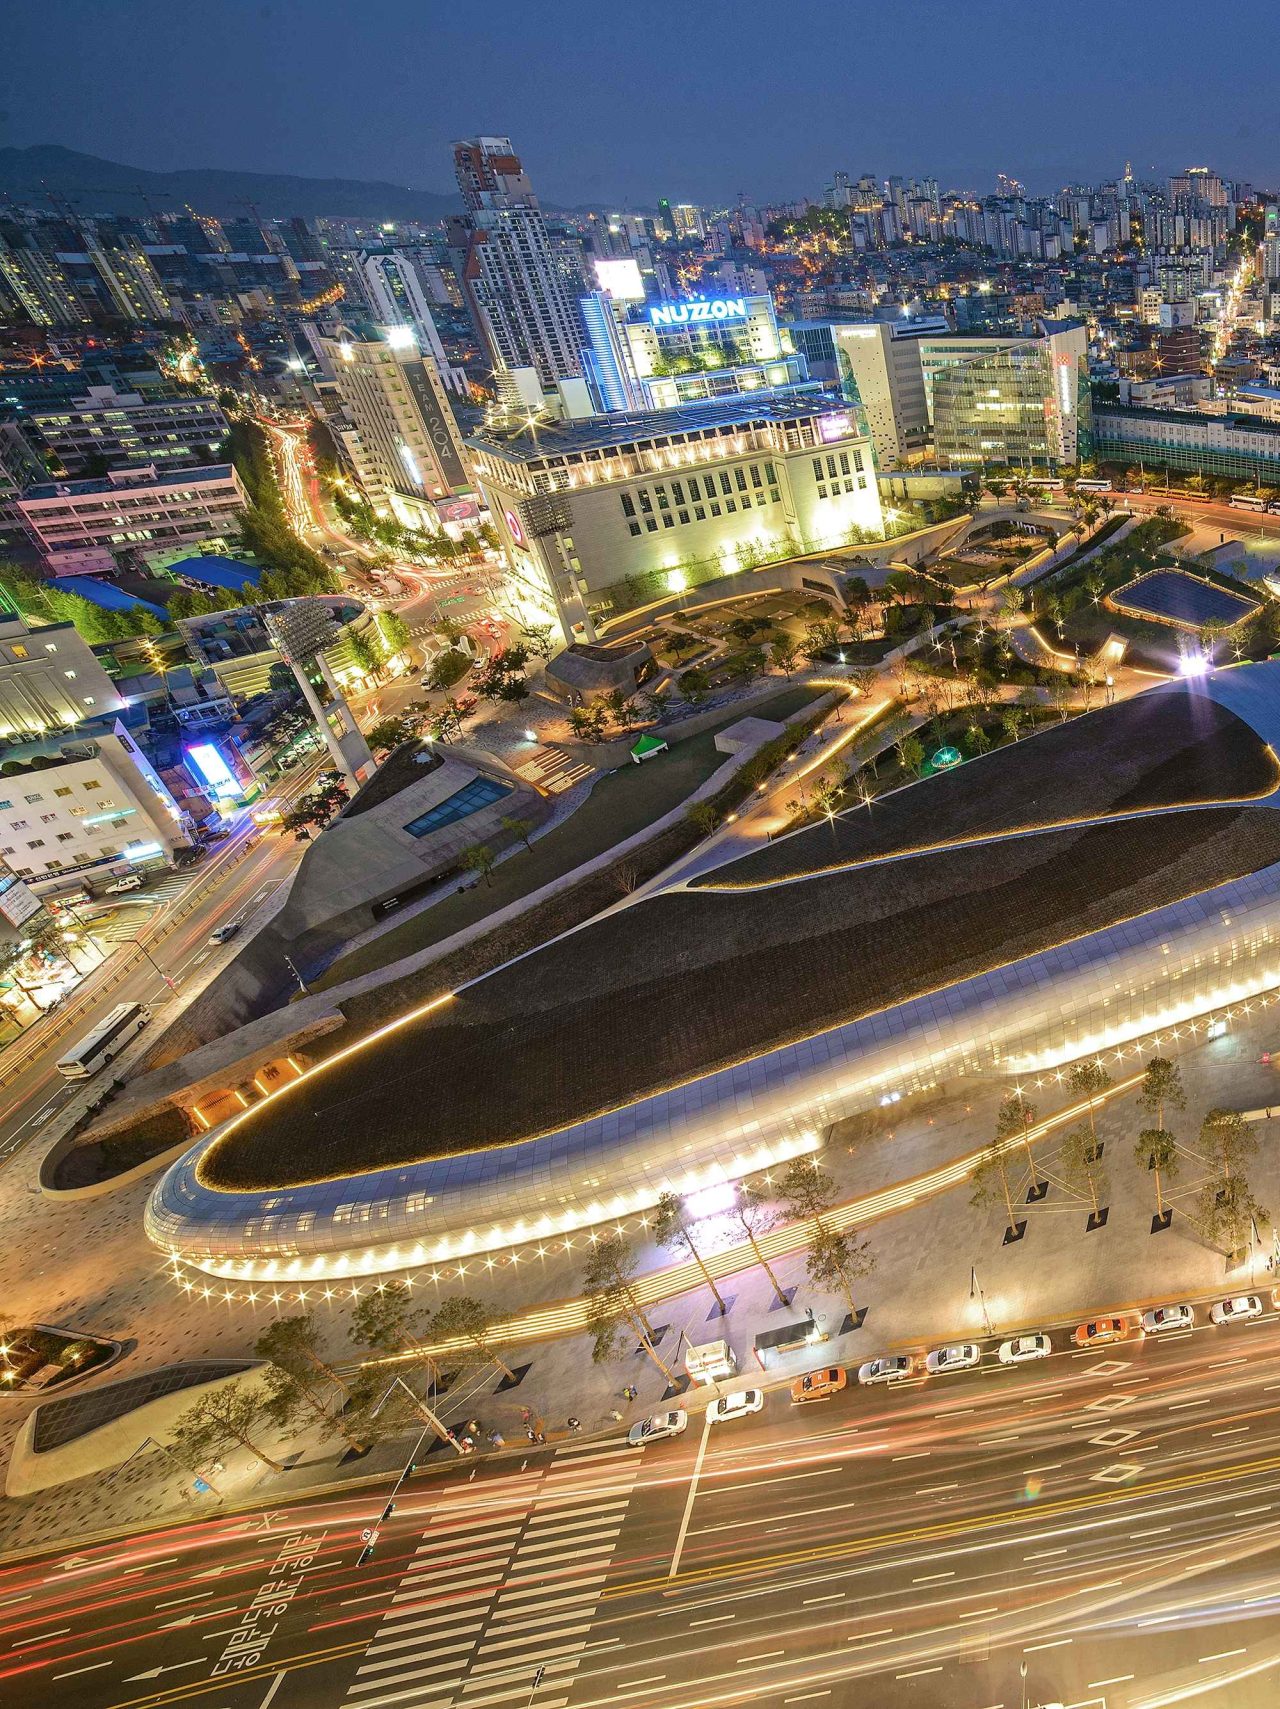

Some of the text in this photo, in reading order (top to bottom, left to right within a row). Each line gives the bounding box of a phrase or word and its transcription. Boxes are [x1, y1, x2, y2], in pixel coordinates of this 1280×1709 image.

[649, 298, 746, 325] NUZZON
[413, 373, 453, 459] TEAM 204
[268, 1530, 328, 1576] 동대문
[241, 1575, 305, 1625] 동대문
[210, 1622, 279, 1677] 동대문
